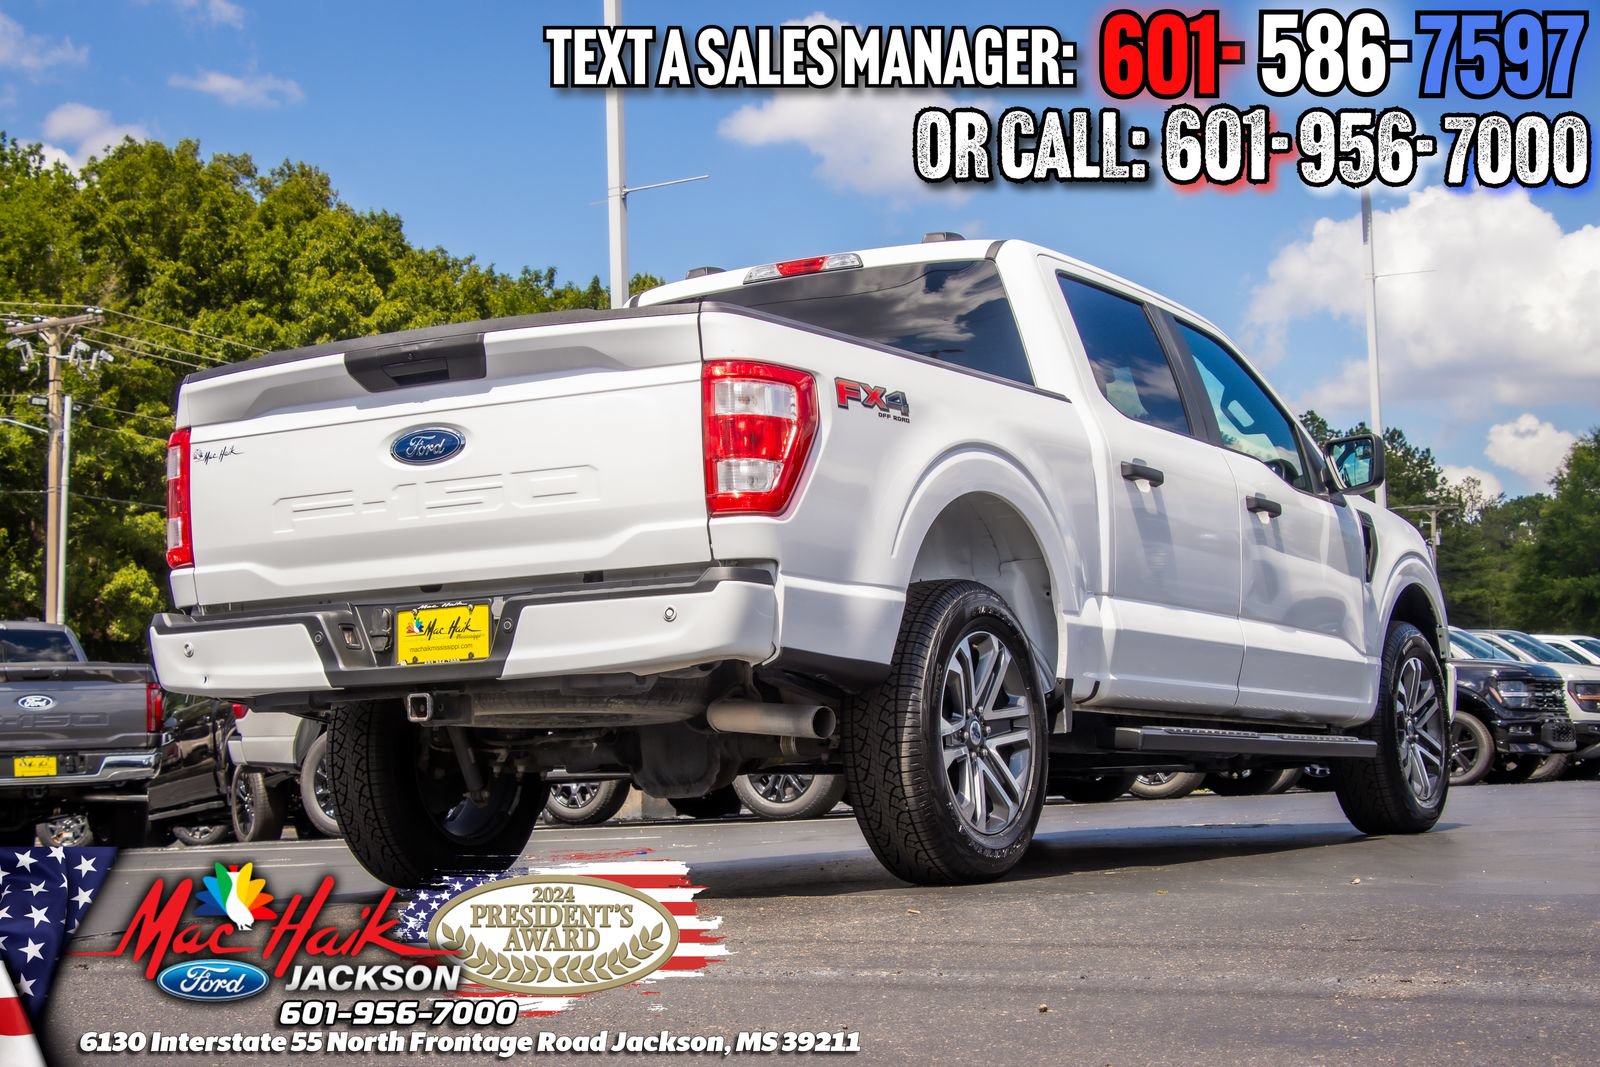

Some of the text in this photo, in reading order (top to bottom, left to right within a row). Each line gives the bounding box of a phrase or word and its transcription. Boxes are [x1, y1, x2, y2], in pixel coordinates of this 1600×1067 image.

[834, 377, 909, 417] FX4
[893, 415, 910, 423] ROAD
[405, 435, 446, 458] Ford
[272, 464, 601, 534] F-150
[423, 616, 481, 640] Mac Haik
[409, 643, 473, 653] machaikmississippi.com
